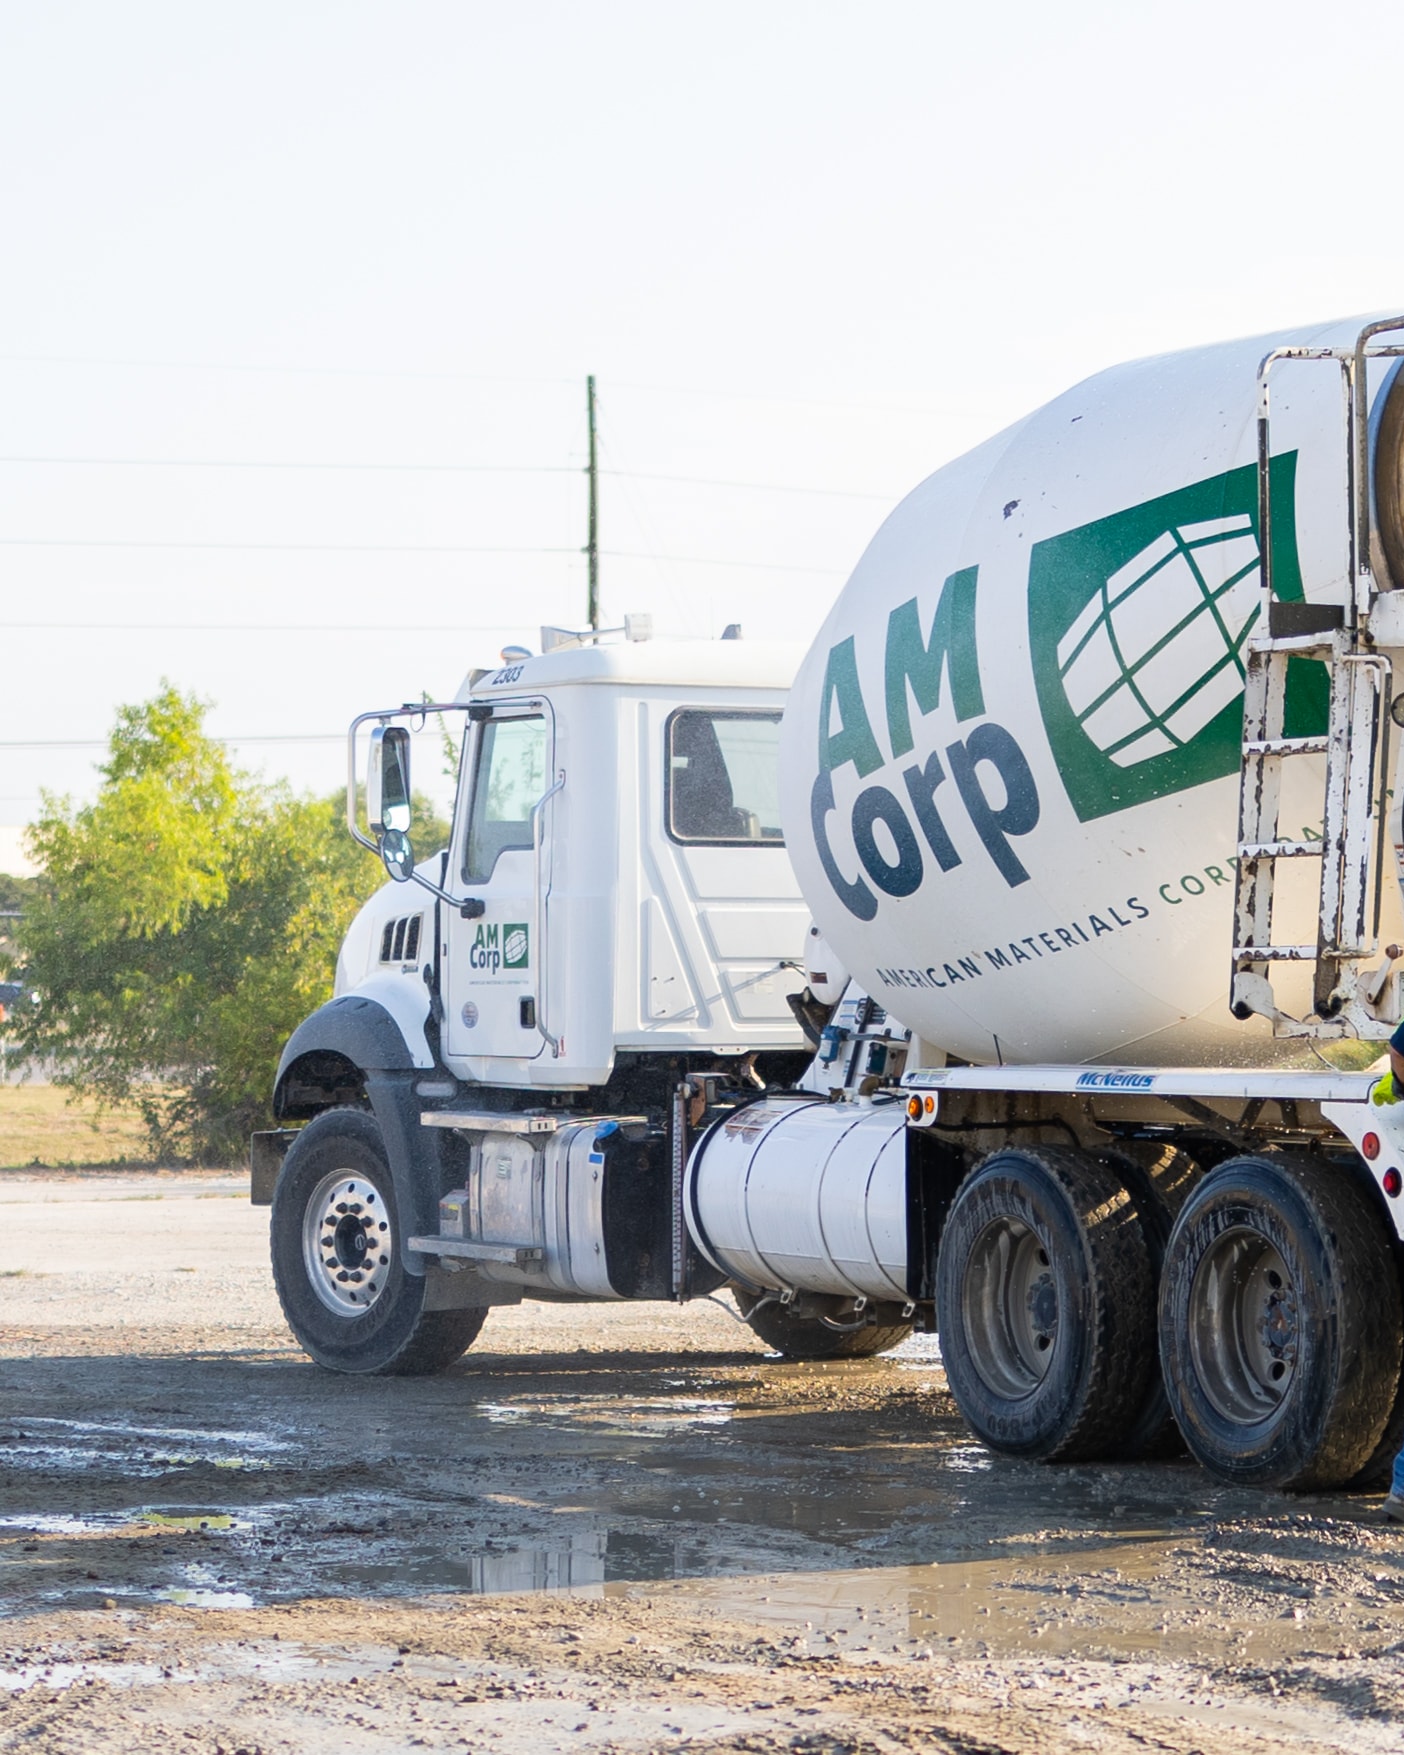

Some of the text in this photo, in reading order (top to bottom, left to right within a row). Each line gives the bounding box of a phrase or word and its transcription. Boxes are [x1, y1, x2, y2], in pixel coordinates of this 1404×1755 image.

[491, 665, 524, 685] 2303
[818, 564, 986, 779] AM
[810, 723, 1040, 922] Corp
[475, 924, 498, 949] AM
[876, 897, 1150, 988] AMERICAN MATERIALS
[470, 943, 500, 975] Corp
[1076, 1072, 1156, 1087] McNeilus
